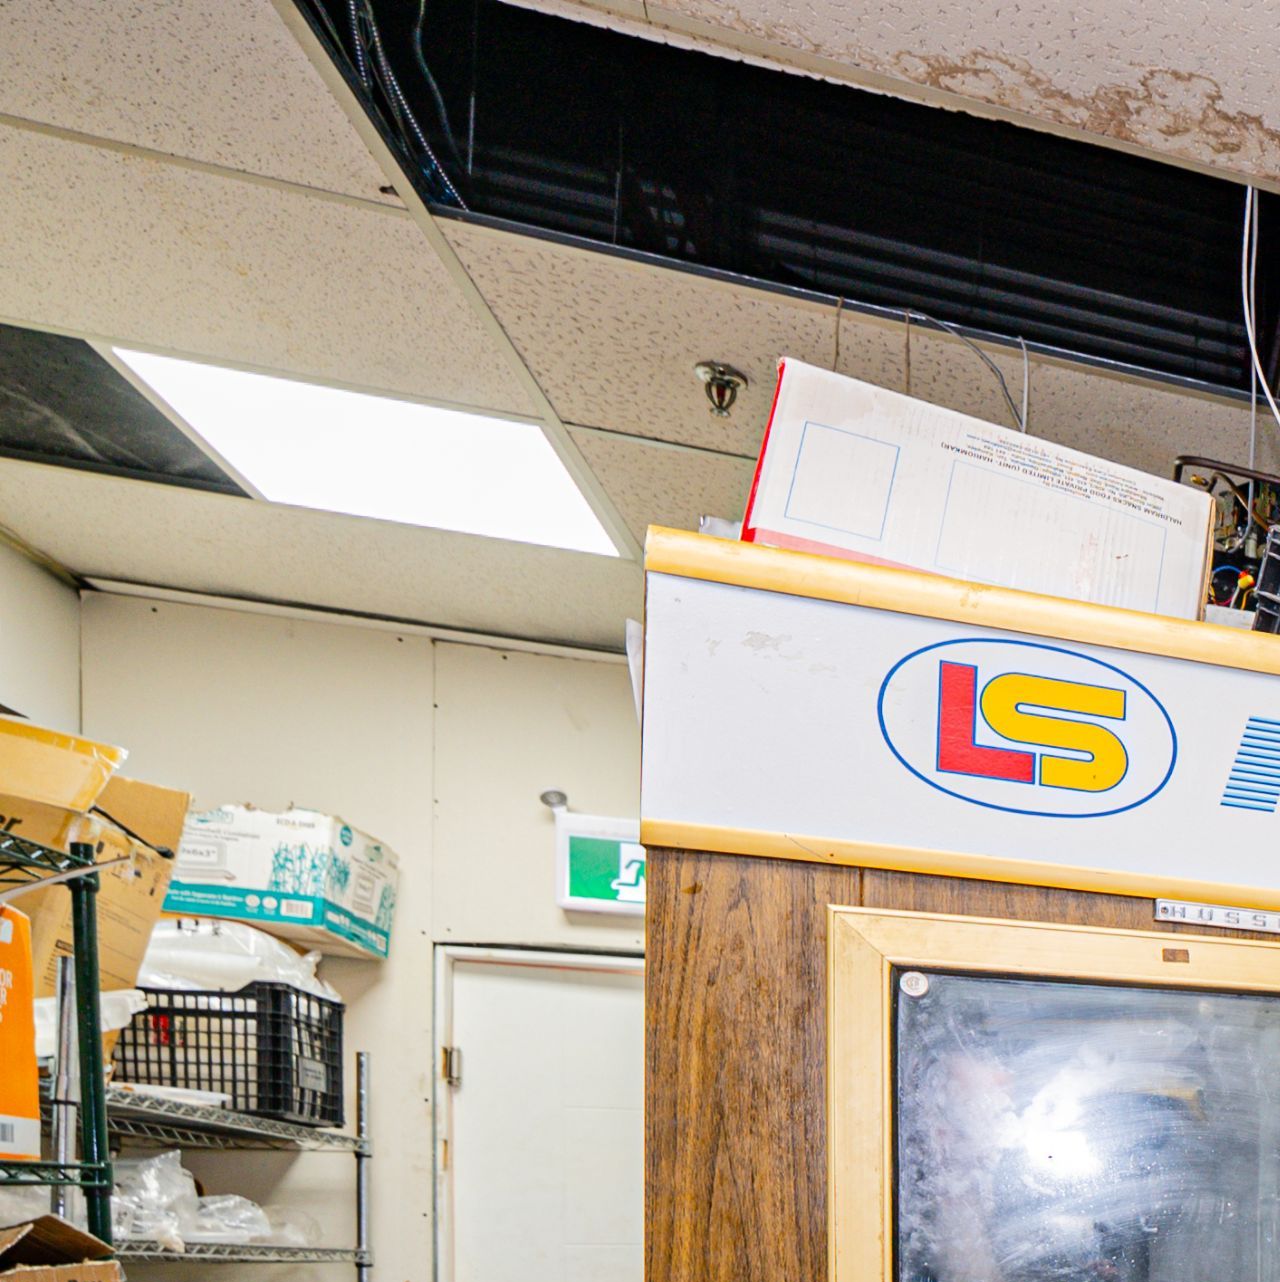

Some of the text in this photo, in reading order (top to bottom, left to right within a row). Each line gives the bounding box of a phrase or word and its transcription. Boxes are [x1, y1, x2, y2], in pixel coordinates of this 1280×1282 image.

[1021, 468, 1054, 482] LIMITED
[1055, 478, 1088, 493] PRIVATE
[936, 660, 1129, 793] LS
